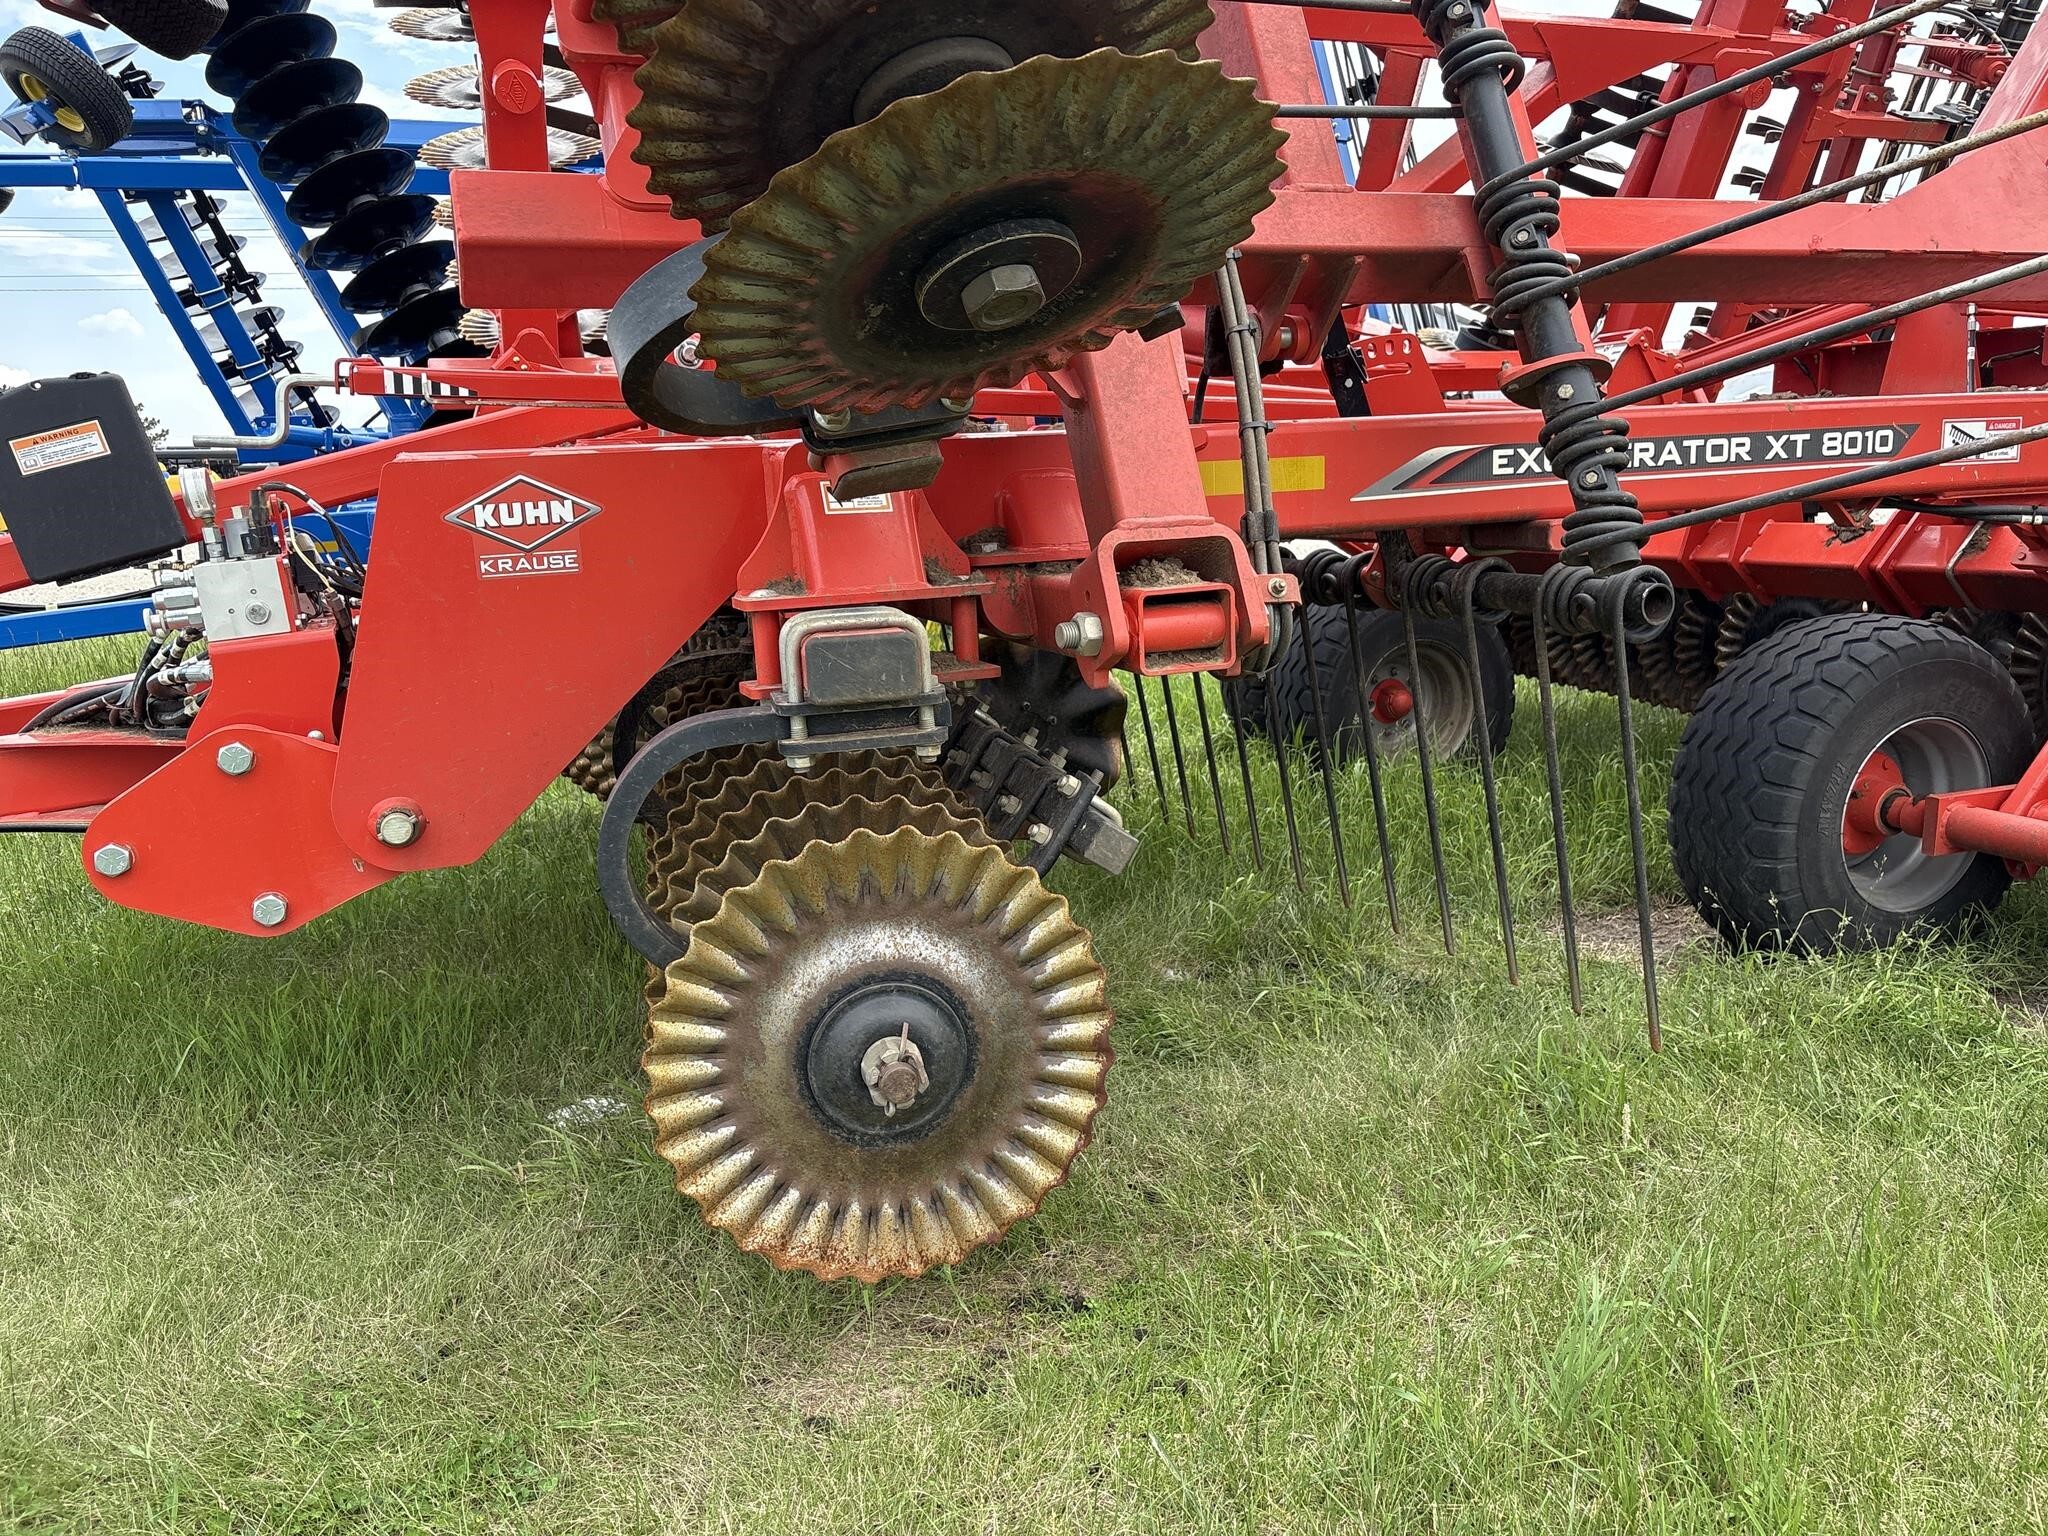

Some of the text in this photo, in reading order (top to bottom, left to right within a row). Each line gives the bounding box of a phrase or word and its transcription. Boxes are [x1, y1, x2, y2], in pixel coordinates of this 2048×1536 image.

[40, 428, 79, 443] WARNING
[1994, 422, 2017, 430] DANGER
[1492, 429, 1894, 476] EXRATOR XT 8010
[473, 499, 575, 528] KUHN
[479, 554, 579, 574] KRAUSE
